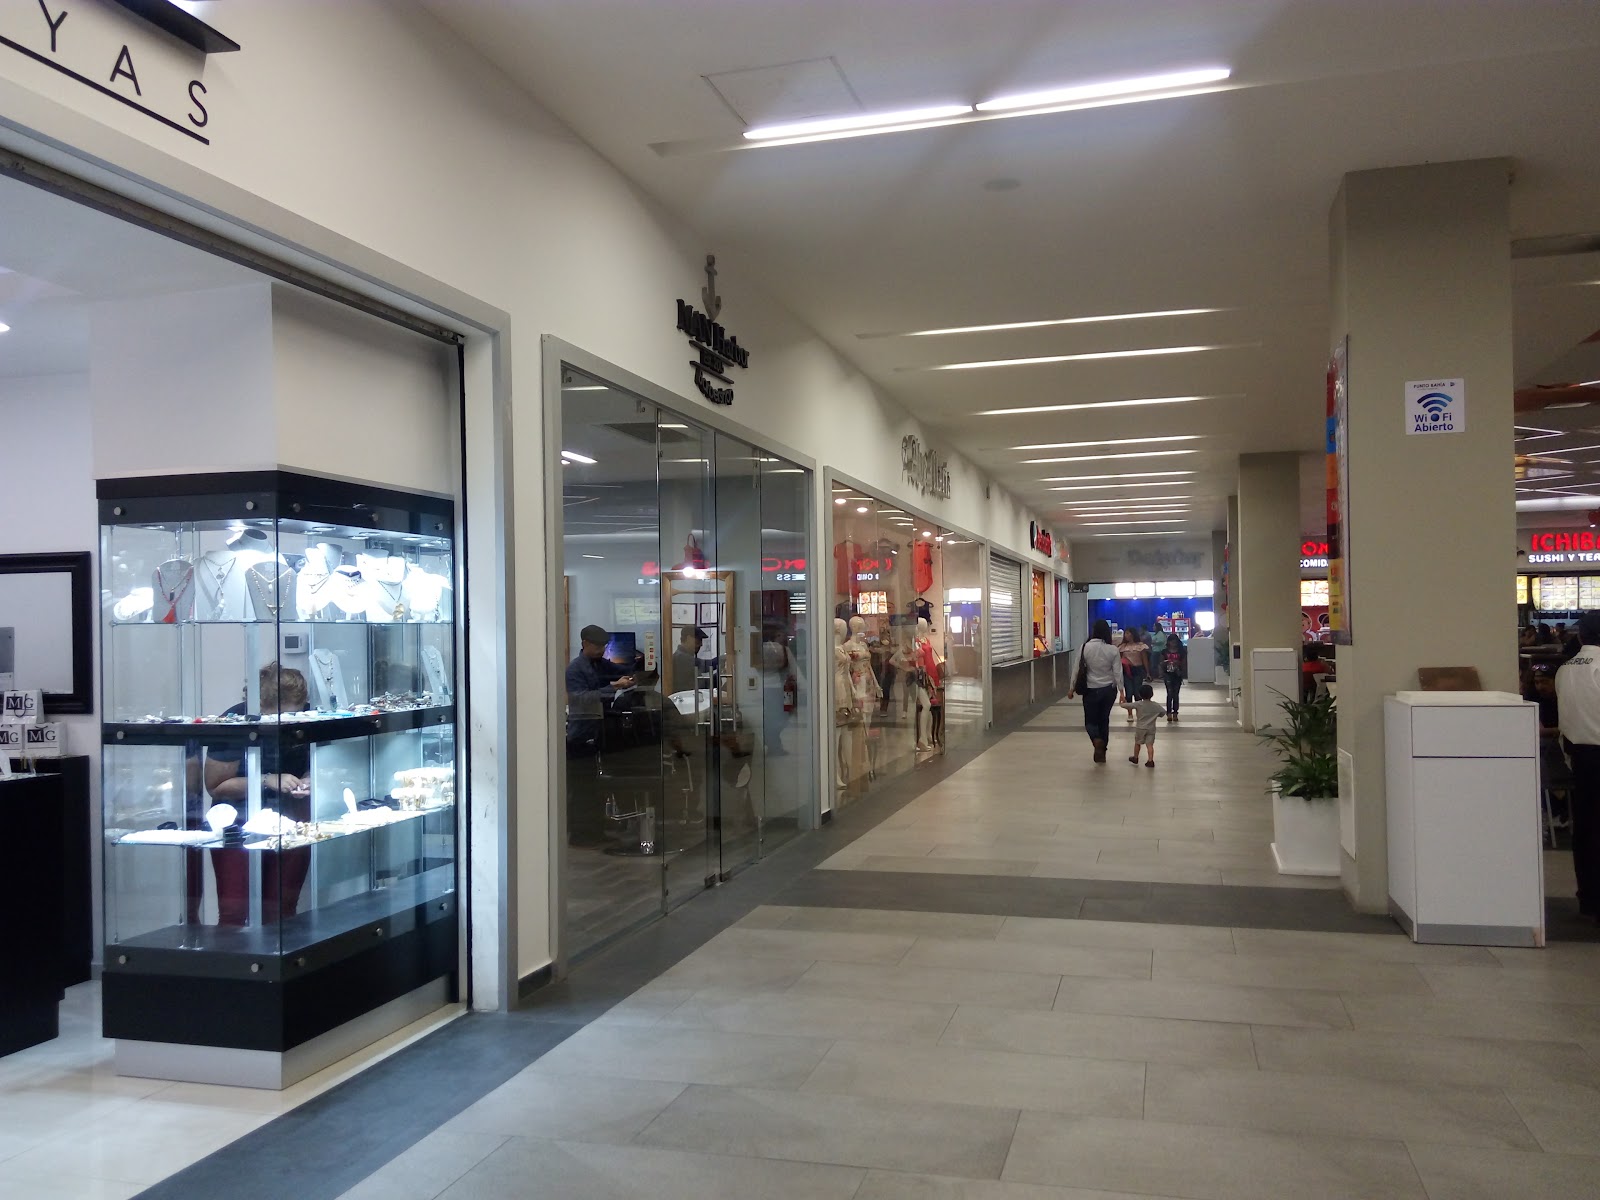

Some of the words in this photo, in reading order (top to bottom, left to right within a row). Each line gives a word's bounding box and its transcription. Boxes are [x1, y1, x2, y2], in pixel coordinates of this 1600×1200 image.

[1414, 423, 1454, 432] Abierto
[1528, 554, 1564, 563] SUSHI
[1567, 554, 1575, 562] Y
[6, 696, 34, 710] MG
[28, 729, 57, 742] MG
